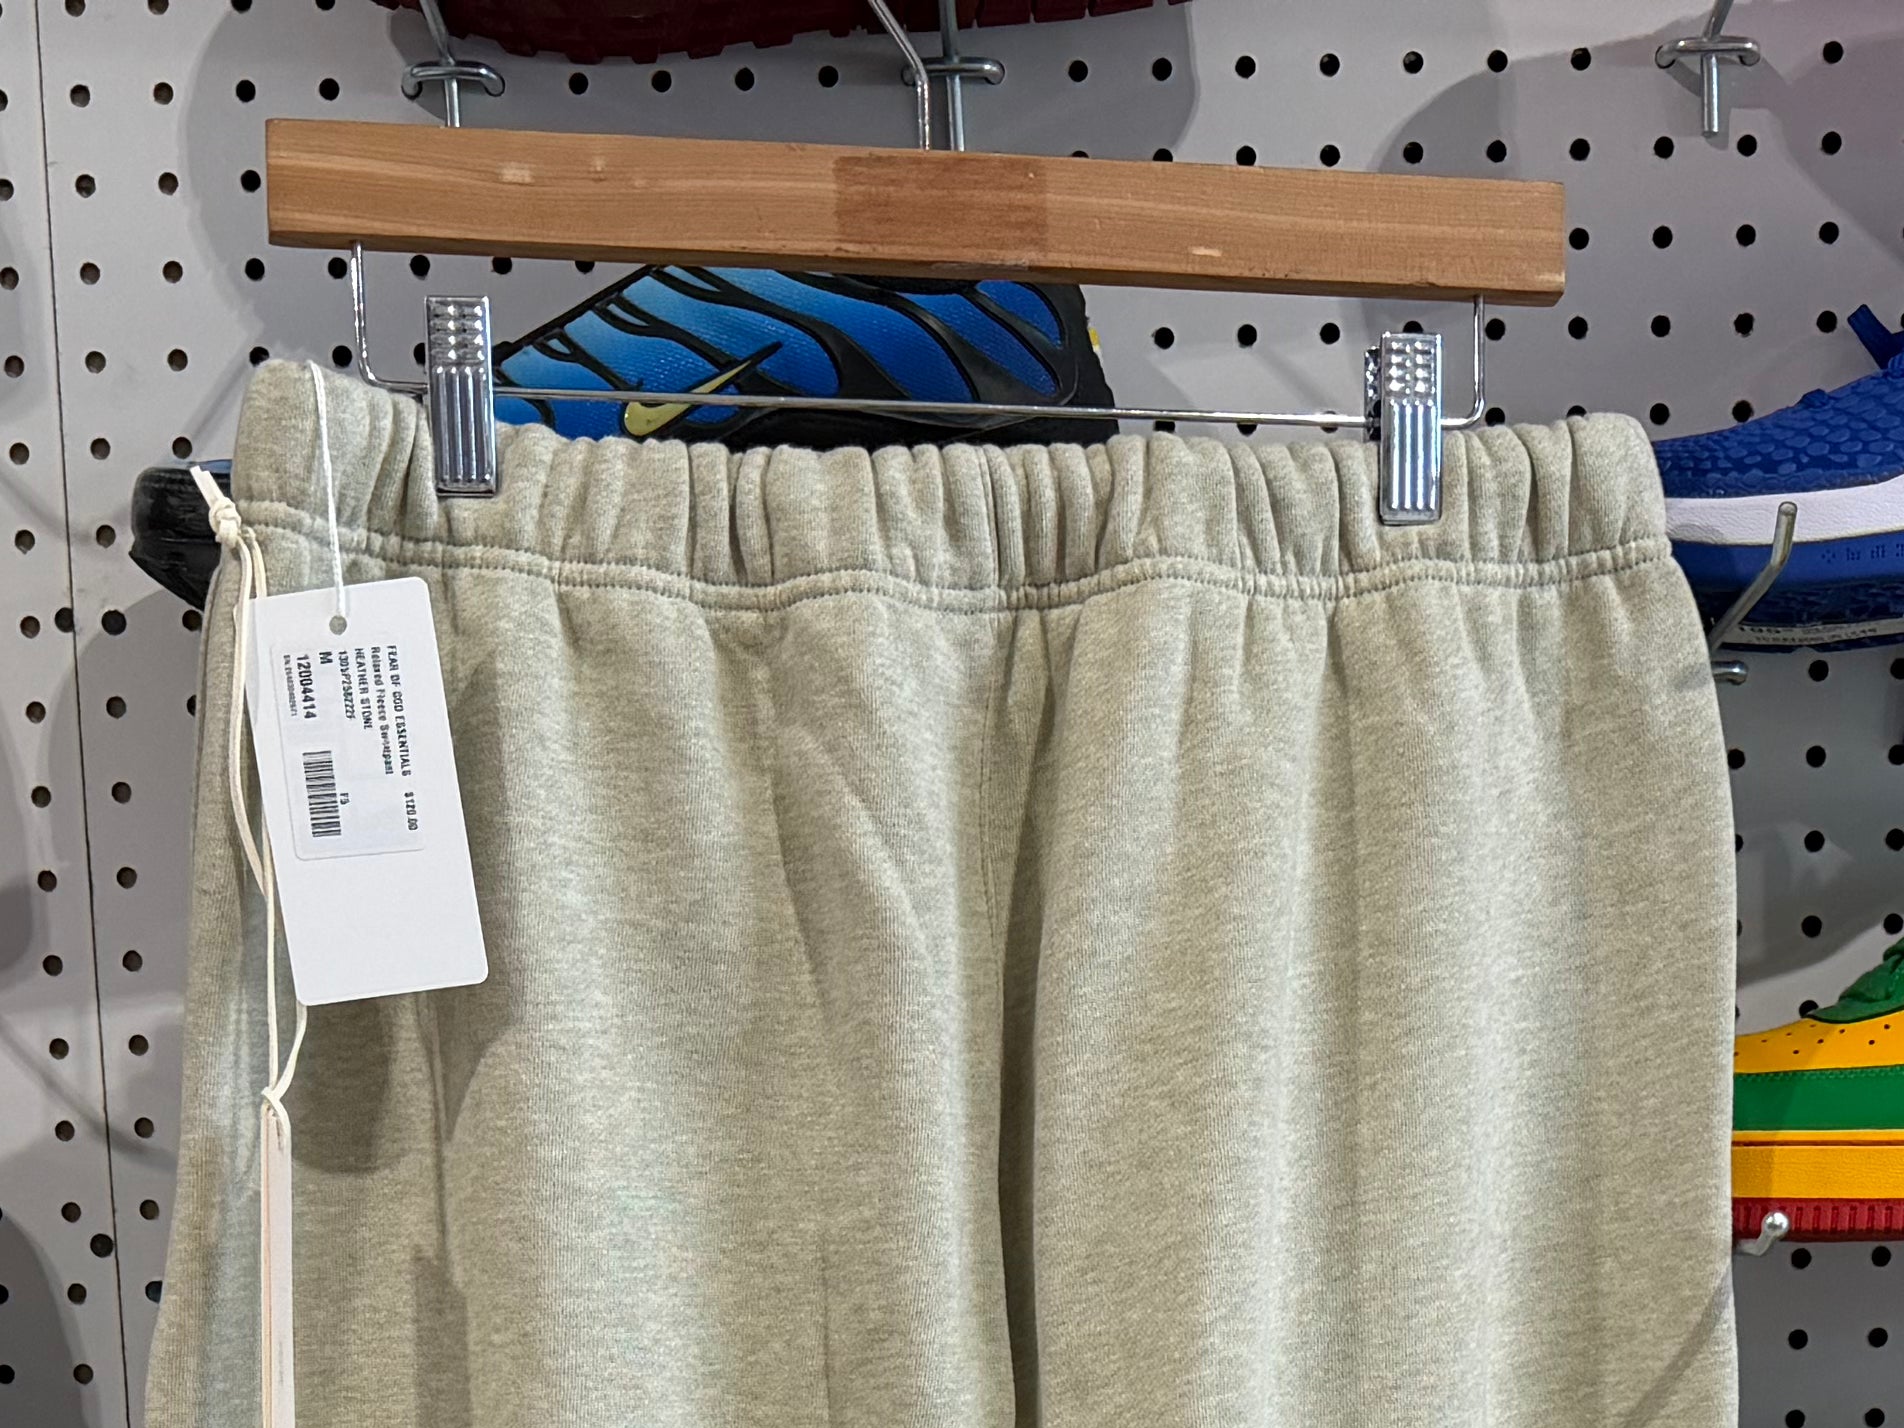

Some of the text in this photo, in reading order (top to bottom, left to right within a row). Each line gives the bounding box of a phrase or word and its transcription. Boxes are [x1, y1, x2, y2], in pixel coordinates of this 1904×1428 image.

[319, 652, 333, 664] M
[387, 646, 398, 671] FEAR
[297, 655, 316, 718] 12004414
[355, 648, 372, 729] HEATHER STONE
[371, 647, 383, 685] Relaxed
[377, 689, 386, 721] Fleece
[390, 675, 400, 687] OF
[393, 692, 403, 712] GOD
[395, 716, 411, 776] ESSENTIALS
